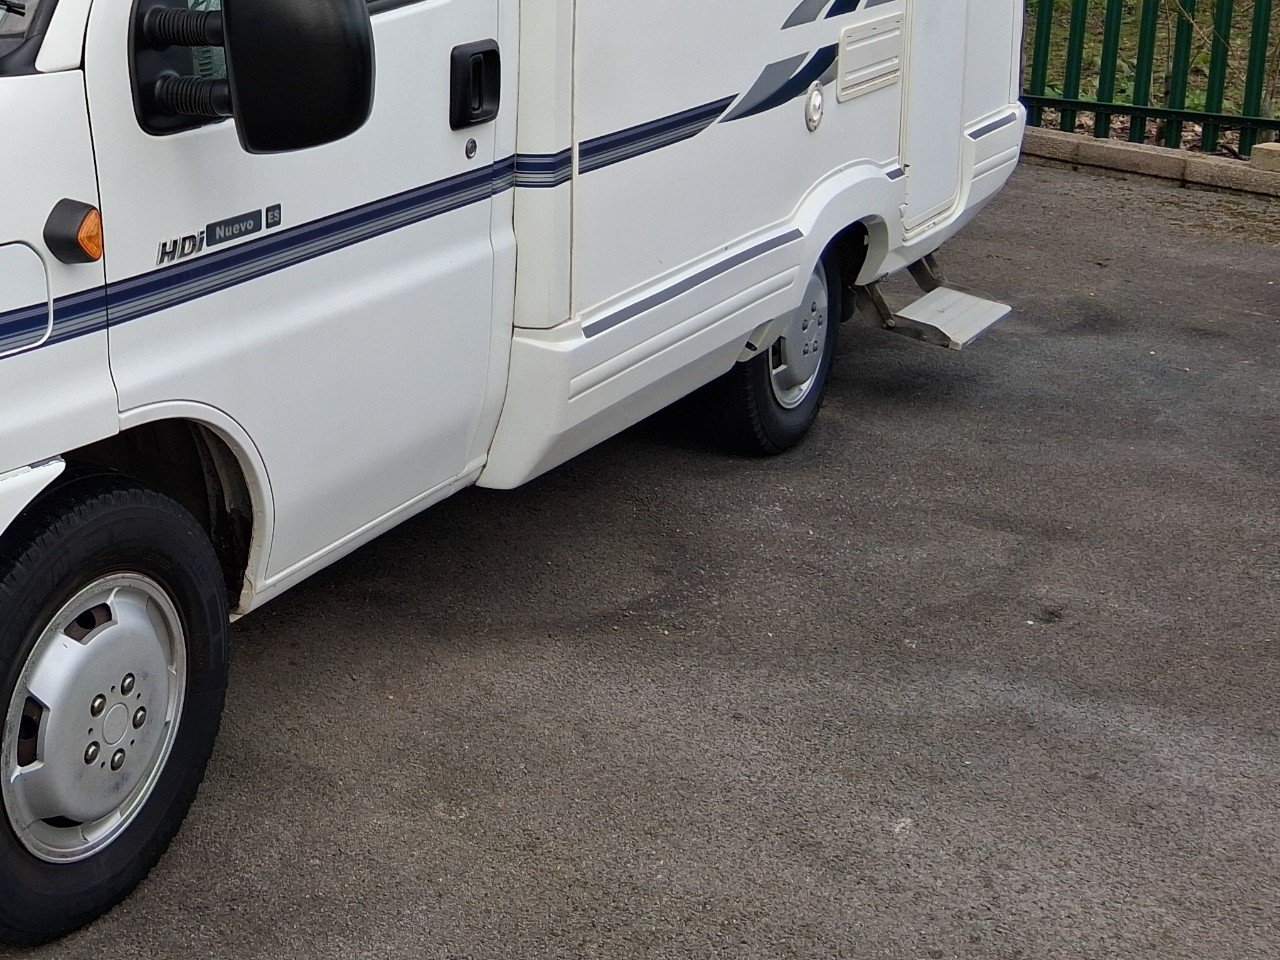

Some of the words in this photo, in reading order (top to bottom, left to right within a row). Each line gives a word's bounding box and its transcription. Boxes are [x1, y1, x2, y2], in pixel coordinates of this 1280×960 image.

[156, 230, 205, 265] HDi
[215, 219, 254, 240] Nuevo
[267, 209, 280, 224] ES
